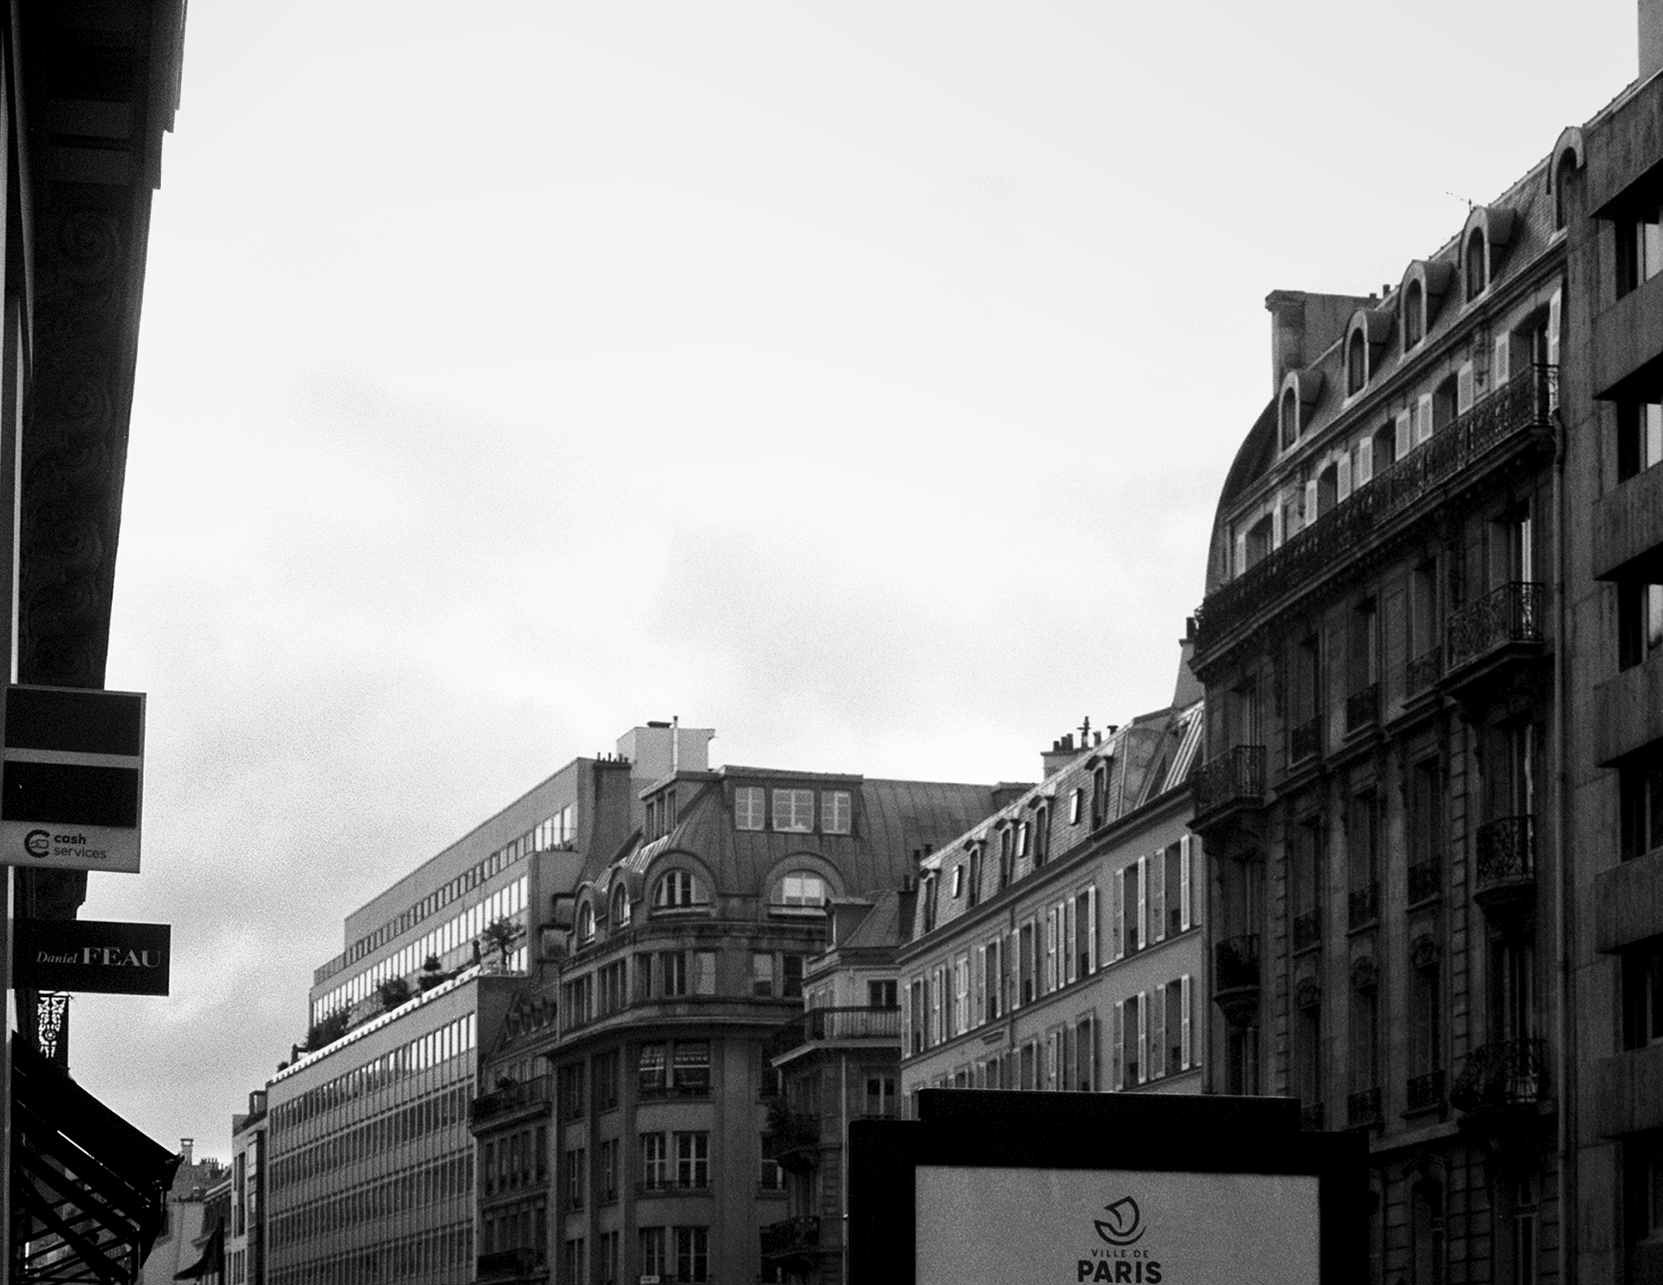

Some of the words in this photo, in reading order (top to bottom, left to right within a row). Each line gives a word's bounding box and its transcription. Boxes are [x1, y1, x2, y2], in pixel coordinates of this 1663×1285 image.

[54, 833, 87, 845] cash
[53, 847, 108, 859] services
[36, 950, 79, 964] Daniel
[82, 947, 161, 968] FEAU
[1091, 1248, 1127, 1258] VILLE
[1133, 1249, 1149, 1259] DE
[1077, 1259, 1162, 1285] PARIS
